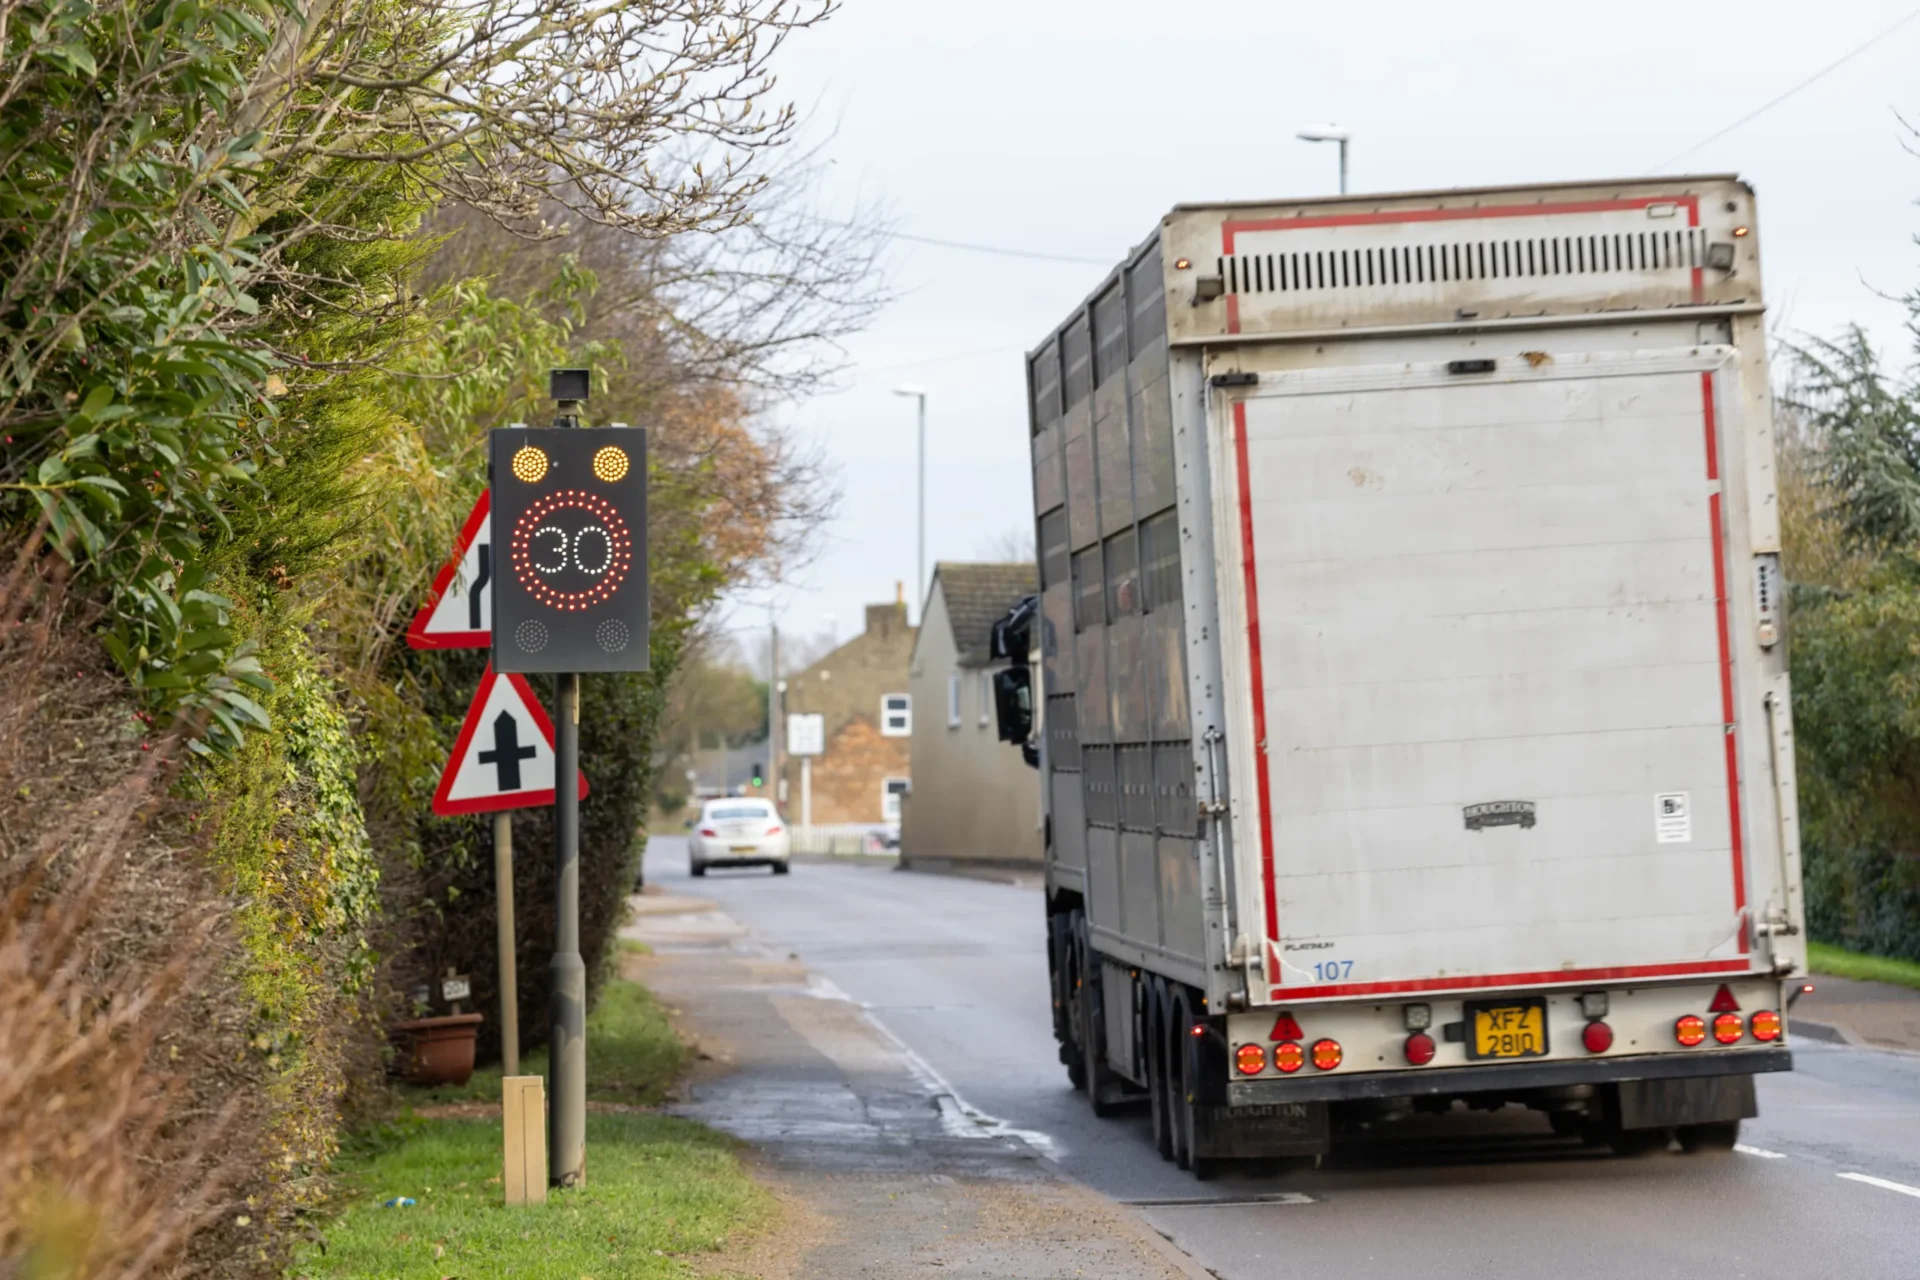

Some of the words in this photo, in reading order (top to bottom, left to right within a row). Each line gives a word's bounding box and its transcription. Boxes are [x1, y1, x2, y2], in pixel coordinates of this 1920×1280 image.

[534, 525, 613, 576] 30
[1314, 960, 1354, 981] 107
[1488, 1009, 1531, 1031] XFZ
[1487, 1032, 1534, 1054] 2810
